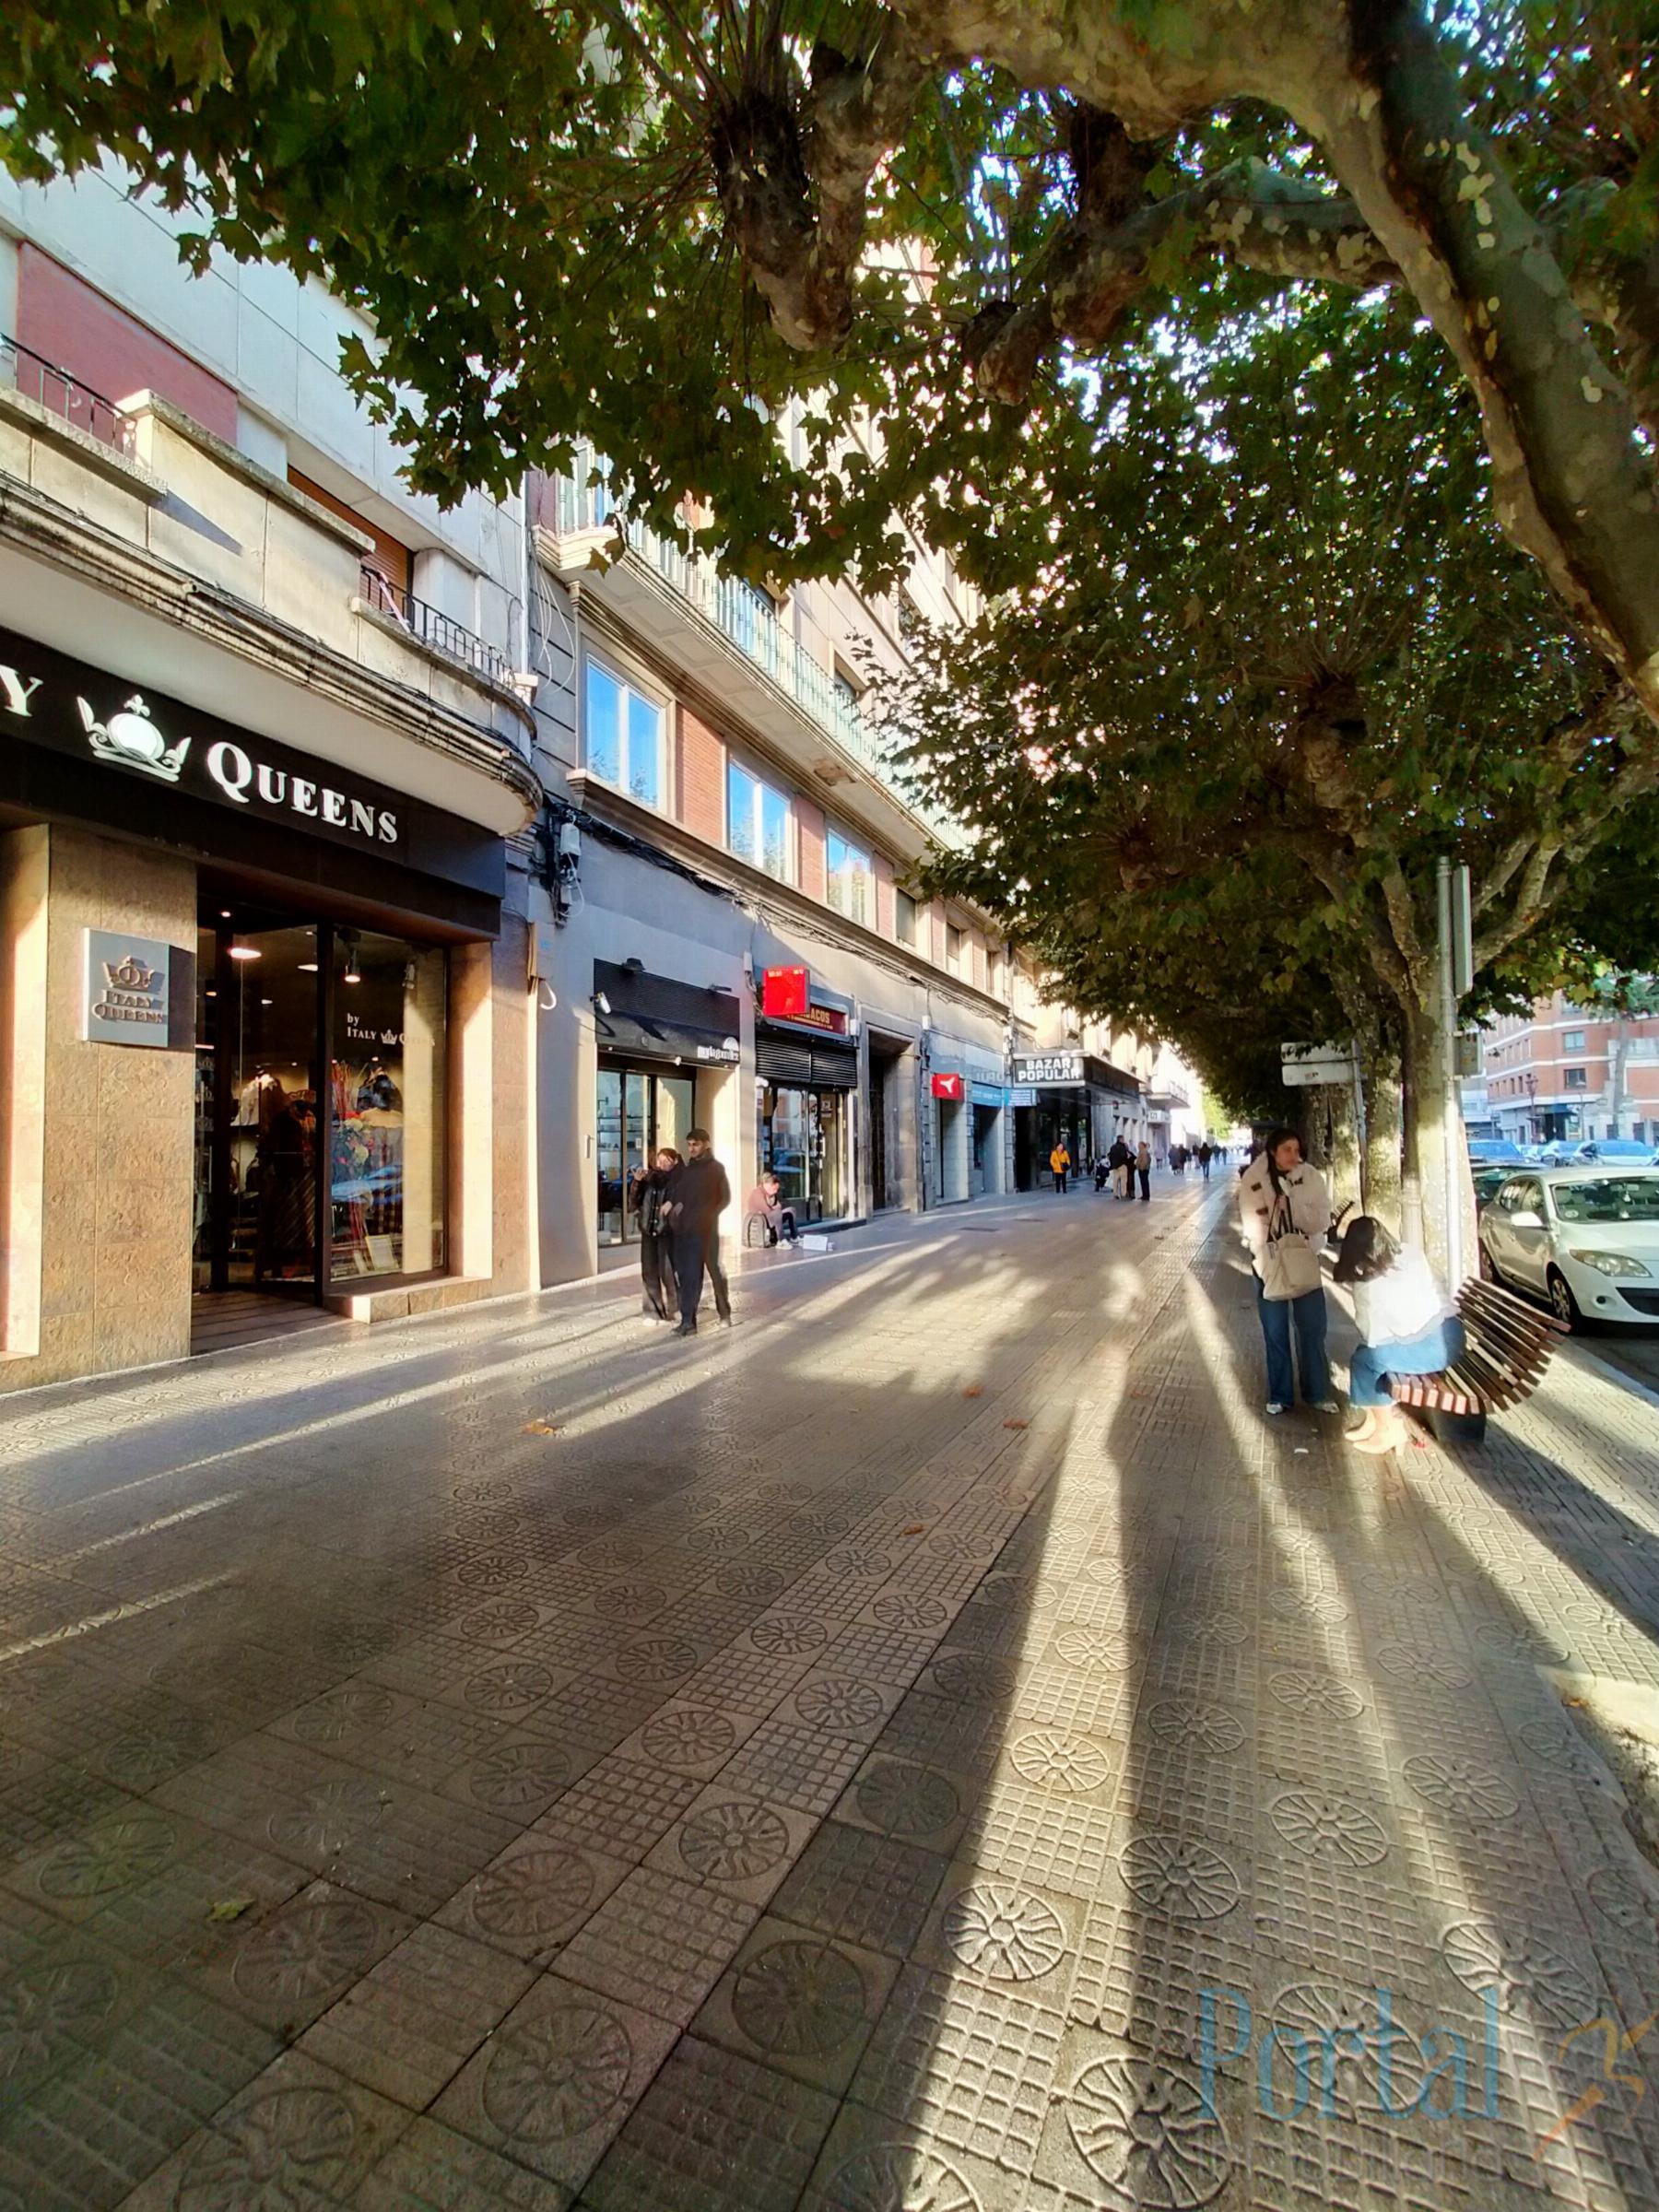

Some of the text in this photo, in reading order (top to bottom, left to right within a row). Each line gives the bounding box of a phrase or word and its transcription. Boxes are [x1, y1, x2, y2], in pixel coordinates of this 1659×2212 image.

[206, 741, 398, 843] QUEENS
[91, 1003, 163, 1023] QUEENS
[347, 1013, 359, 1027] by
[347, 1026, 376, 1040] ITALY
[1026, 1057, 1071, 1070] BAZAR
[1018, 1068, 1079, 1082] POPULAR
